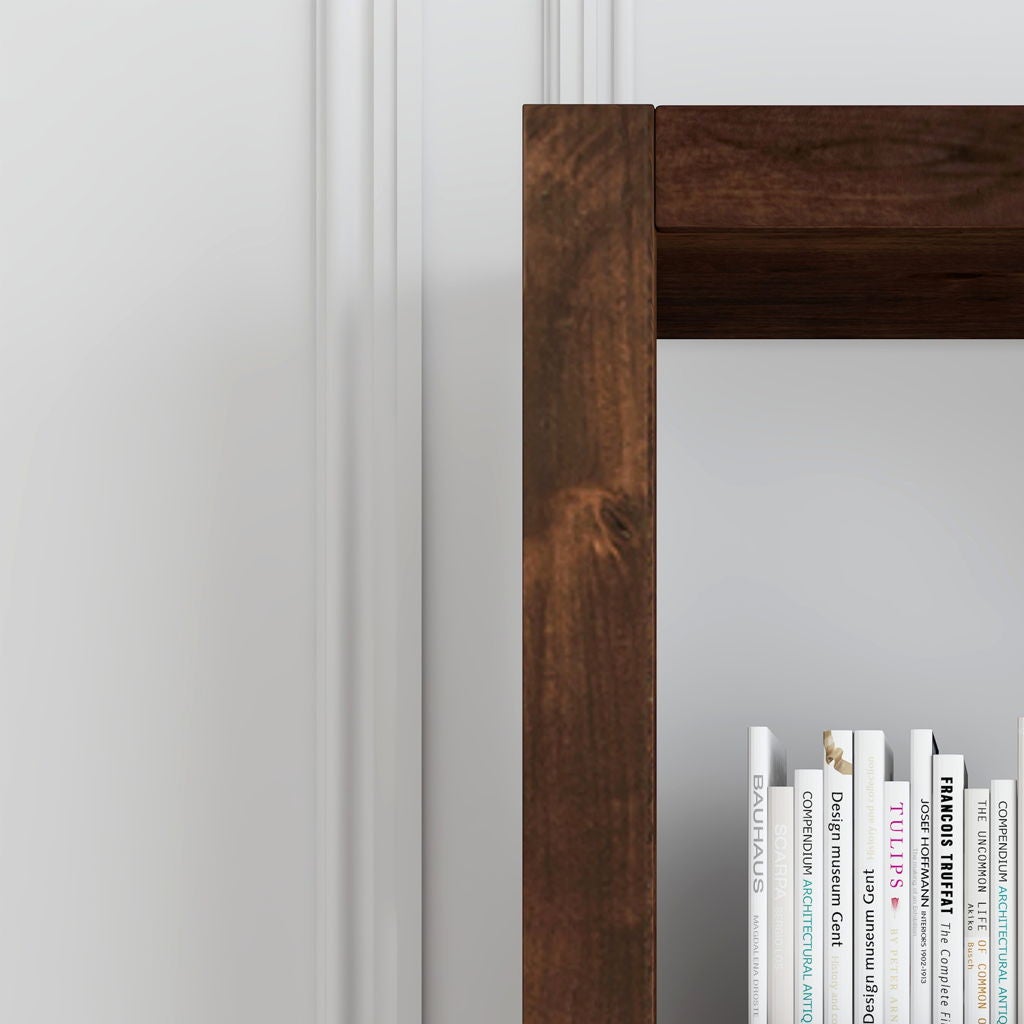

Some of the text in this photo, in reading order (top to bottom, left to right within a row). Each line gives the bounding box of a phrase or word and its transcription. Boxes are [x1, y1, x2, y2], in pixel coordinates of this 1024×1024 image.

[752, 774, 764, 893] BAUHAUS
[802, 791, 813, 876] COMPENDIUM
[920, 798, 929, 834] JOSEF
[941, 776, 953, 847] FRANCOIS
[977, 800, 987, 821] THE
[998, 801, 1008, 882] COMPENDIUM
[774, 824, 787, 900] SCARPA
[828, 792, 843, 947] Design museum Gent
[890, 802, 904, 888] TULIPS
[920, 837, 929, 908] HOFFMANN
[977, 830, 987, 893] UNCOMMON
[941, 854, 953, 914] TRUFFAT
[977, 902, 987, 931] LIFE
[802, 879, 813, 980] ARCHITECTURAL
[862, 869, 878, 1024] Design museum Gent
[890, 928, 898, 943] BY
[940, 922, 951, 944] The
[977, 940, 987, 954] OF
[998, 886, 1008, 984] ARCHITECTURAL
[890, 950, 898, 991] PETER
[938, 950, 951, 1007] Complete
[977, 963, 987, 1010] COMMON
